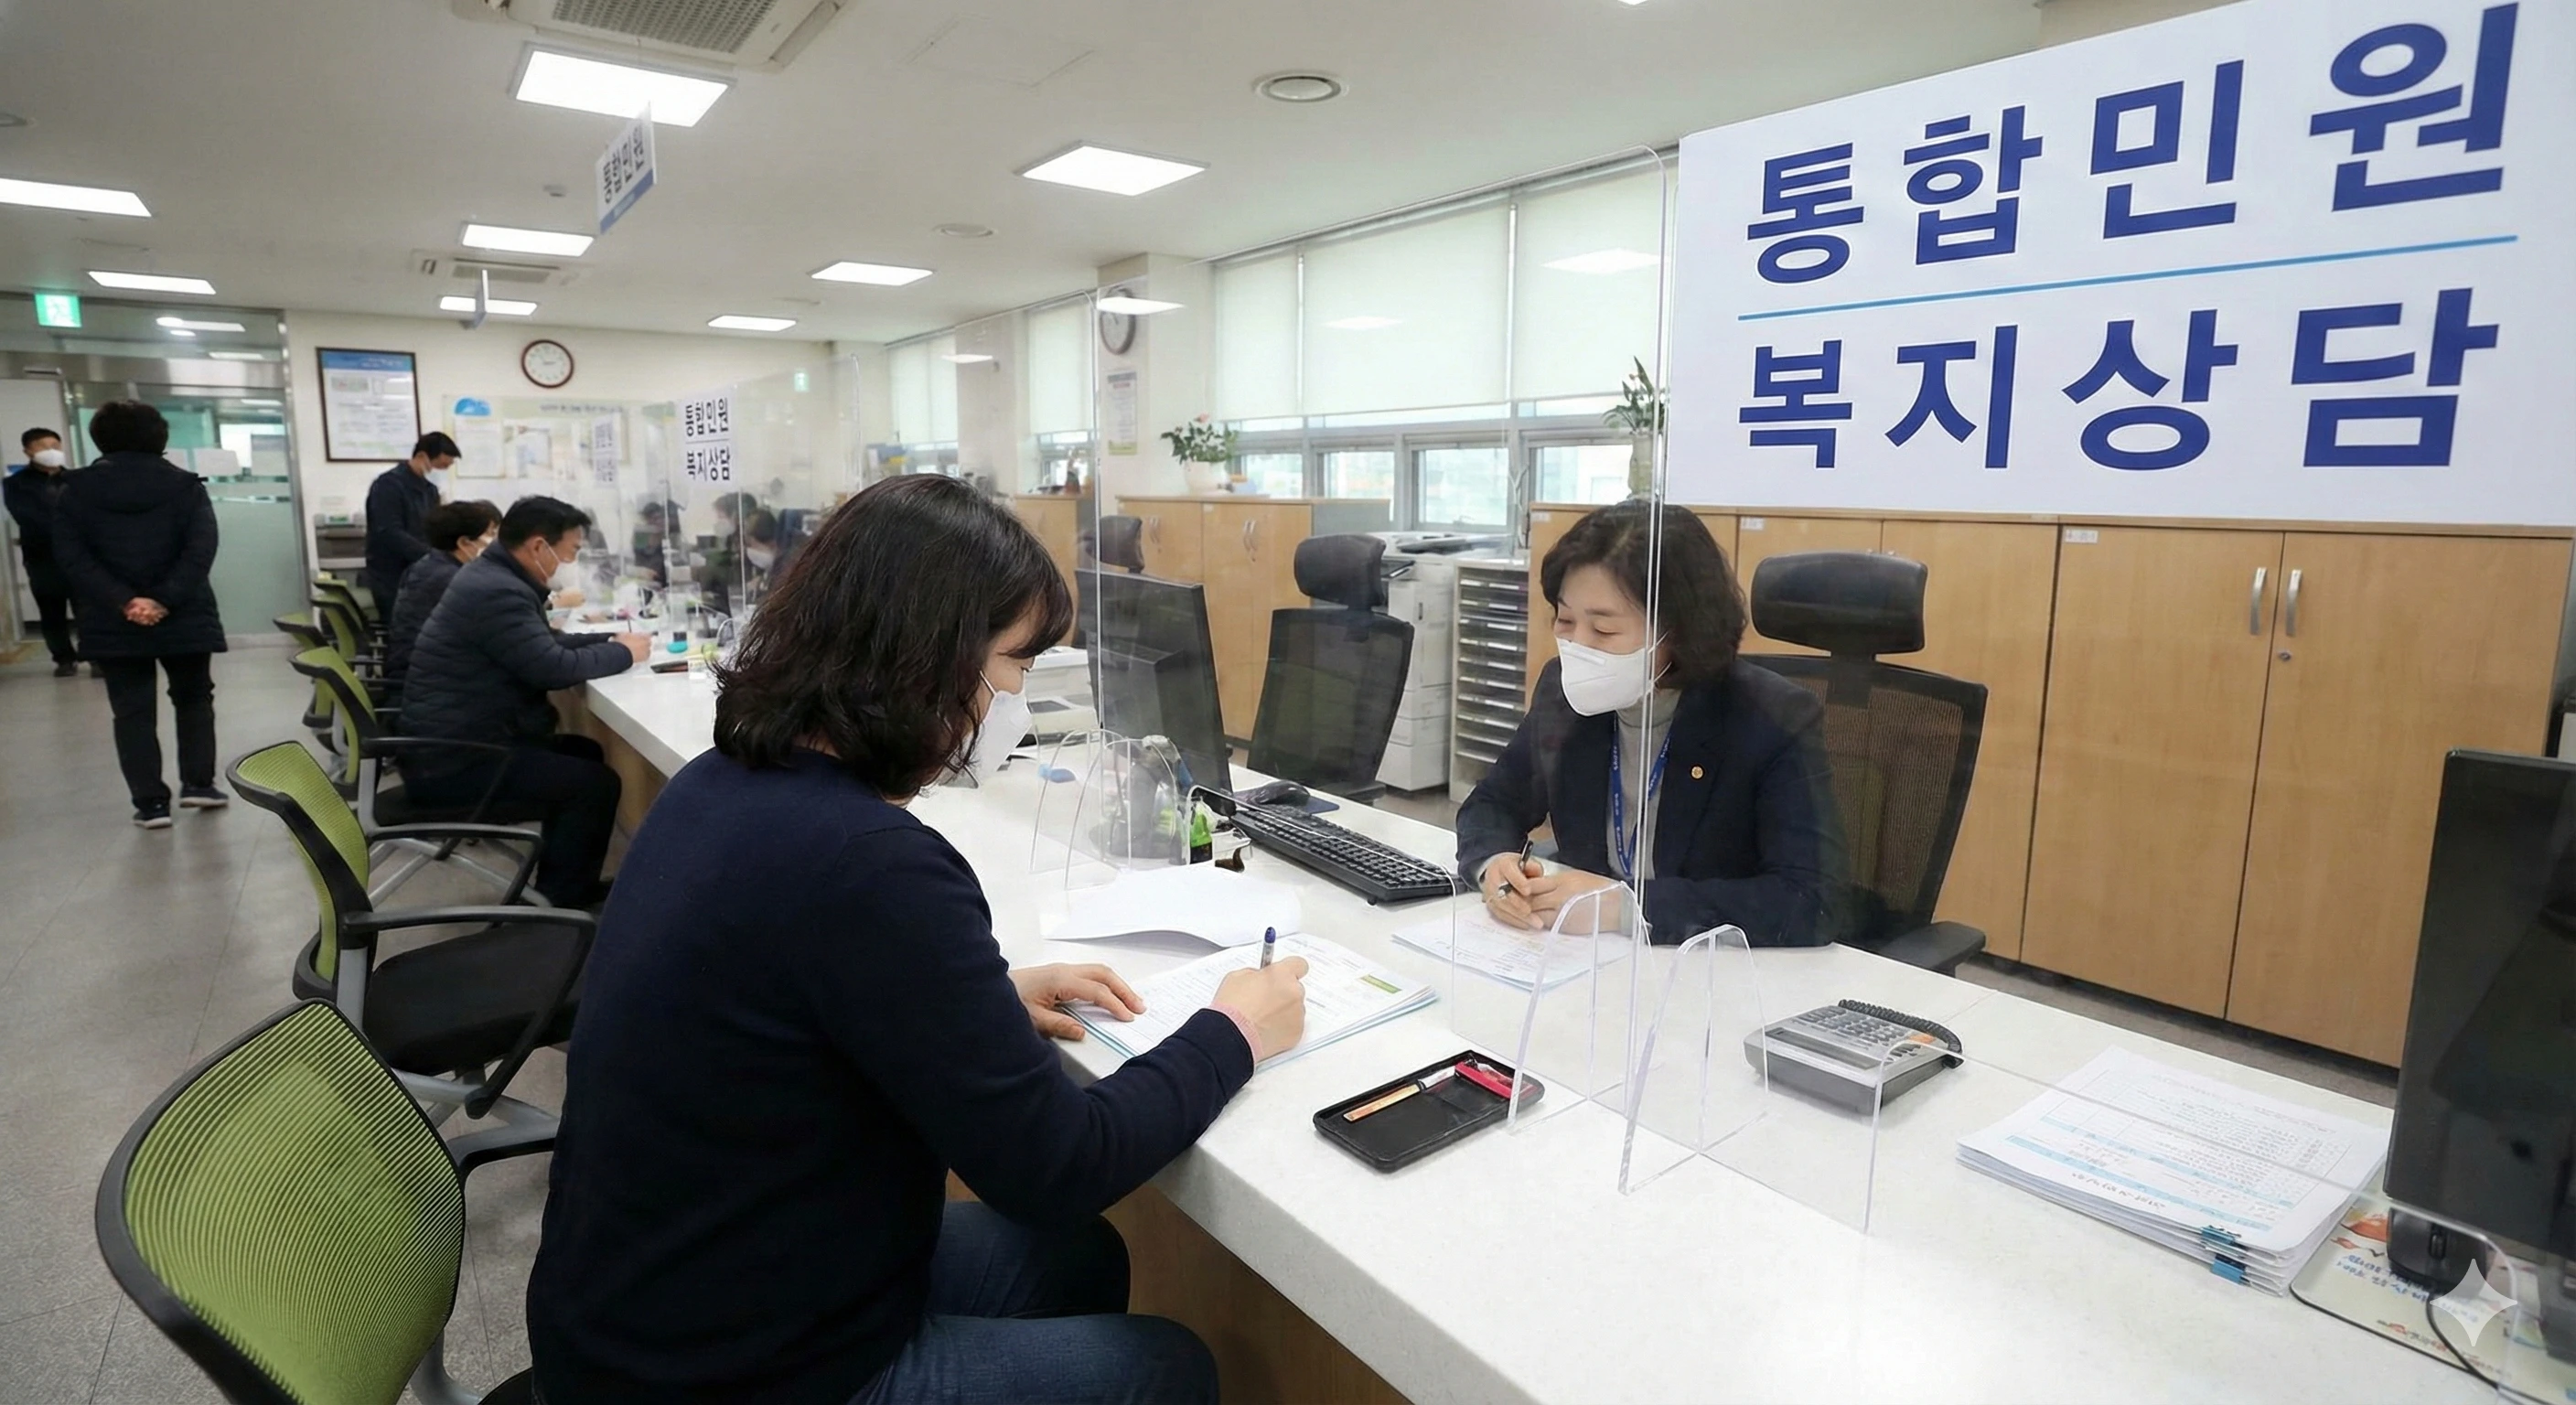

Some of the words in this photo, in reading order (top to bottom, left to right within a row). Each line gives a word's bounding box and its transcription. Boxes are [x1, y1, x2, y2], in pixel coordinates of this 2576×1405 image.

[1746, 3, 2518, 284] 통합민원
[685, 397, 729, 436] 통합민원
[1738, 287, 2499, 470] 복지상담
[687, 445, 731, 481] 복지상담
